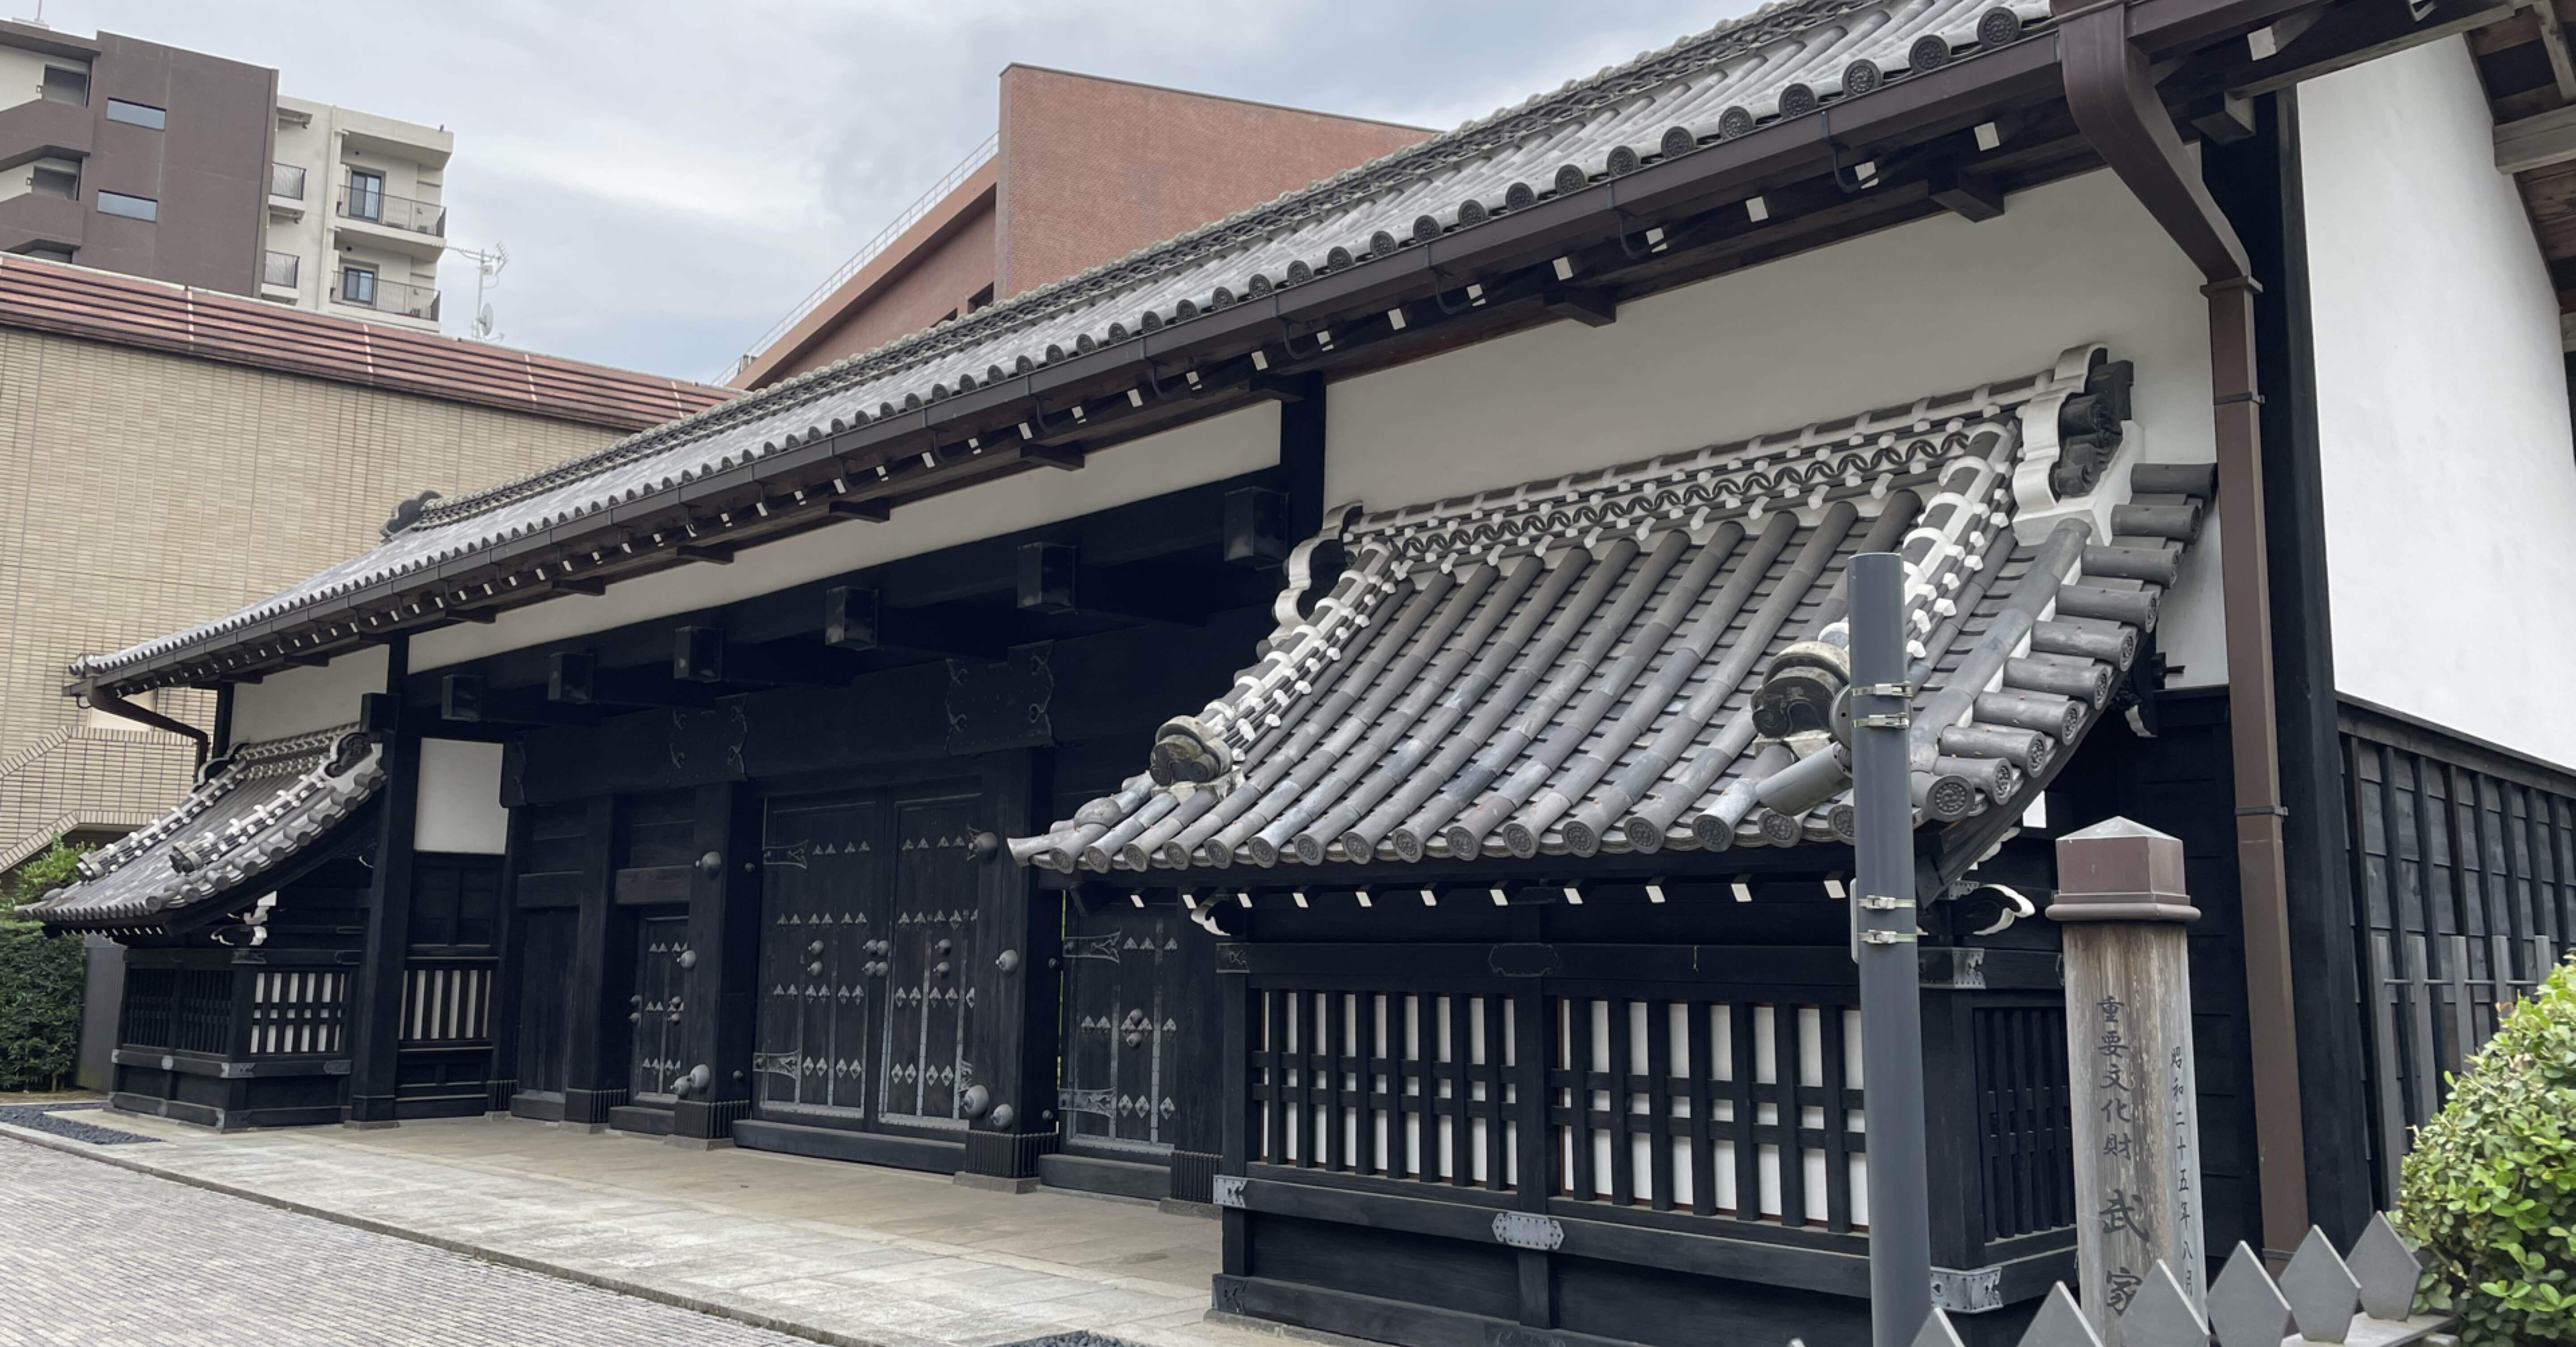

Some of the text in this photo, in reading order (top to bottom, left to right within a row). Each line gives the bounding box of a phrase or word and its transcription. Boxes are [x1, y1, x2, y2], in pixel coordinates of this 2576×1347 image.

[2097, 995, 2132, 1160] 重要文化財
[2170, 1046, 2193, 1297] 昭和二十五年八月
